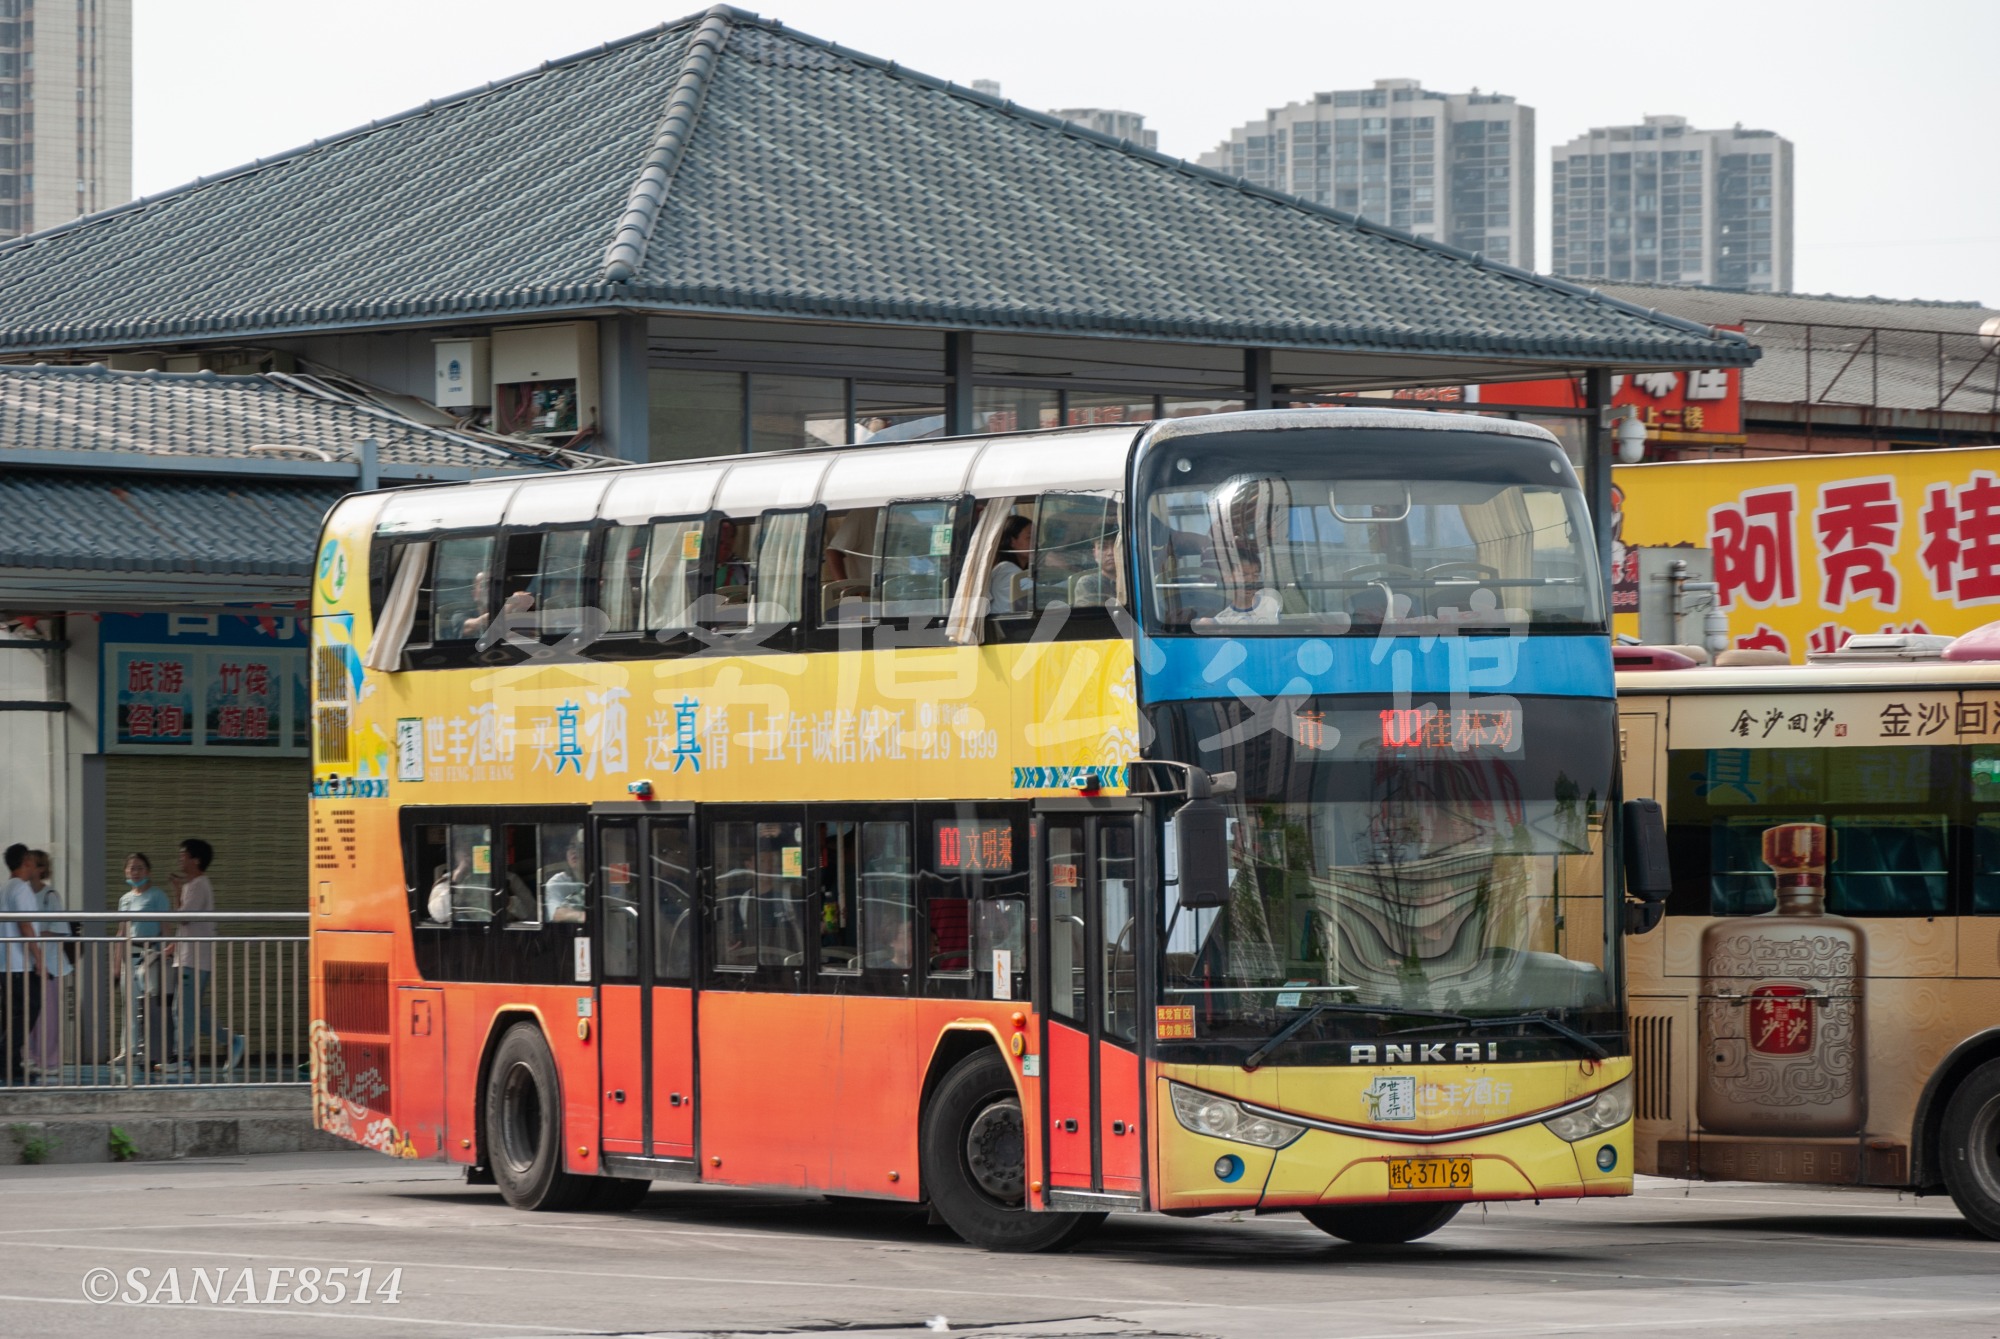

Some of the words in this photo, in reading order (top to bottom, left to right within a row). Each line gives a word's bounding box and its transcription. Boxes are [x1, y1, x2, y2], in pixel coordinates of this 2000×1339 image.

[128, 660, 184, 693] 旅游
[219, 663, 269, 695] 竹筏
[128, 704, 184, 737] 咨询
[218, 706, 269, 739] 游船
[426, 702, 516, 766] 世丰酒行
[531, 687, 631, 781] 买真酒
[644, 695, 730, 773] 送真情
[740, 708, 907, 763] 十五年诚信保证
[1379, 709, 1422, 747] 100
[1730, 707, 1835, 738] 金沙回沙
[921, 731, 951, 760] 219
[960, 729, 998, 760] 1999
[940, 827, 960, 866] 100
[1350, 1042, 1497, 1063] ANKAI
[1419, 1078, 1512, 1108] 世丰酒行
